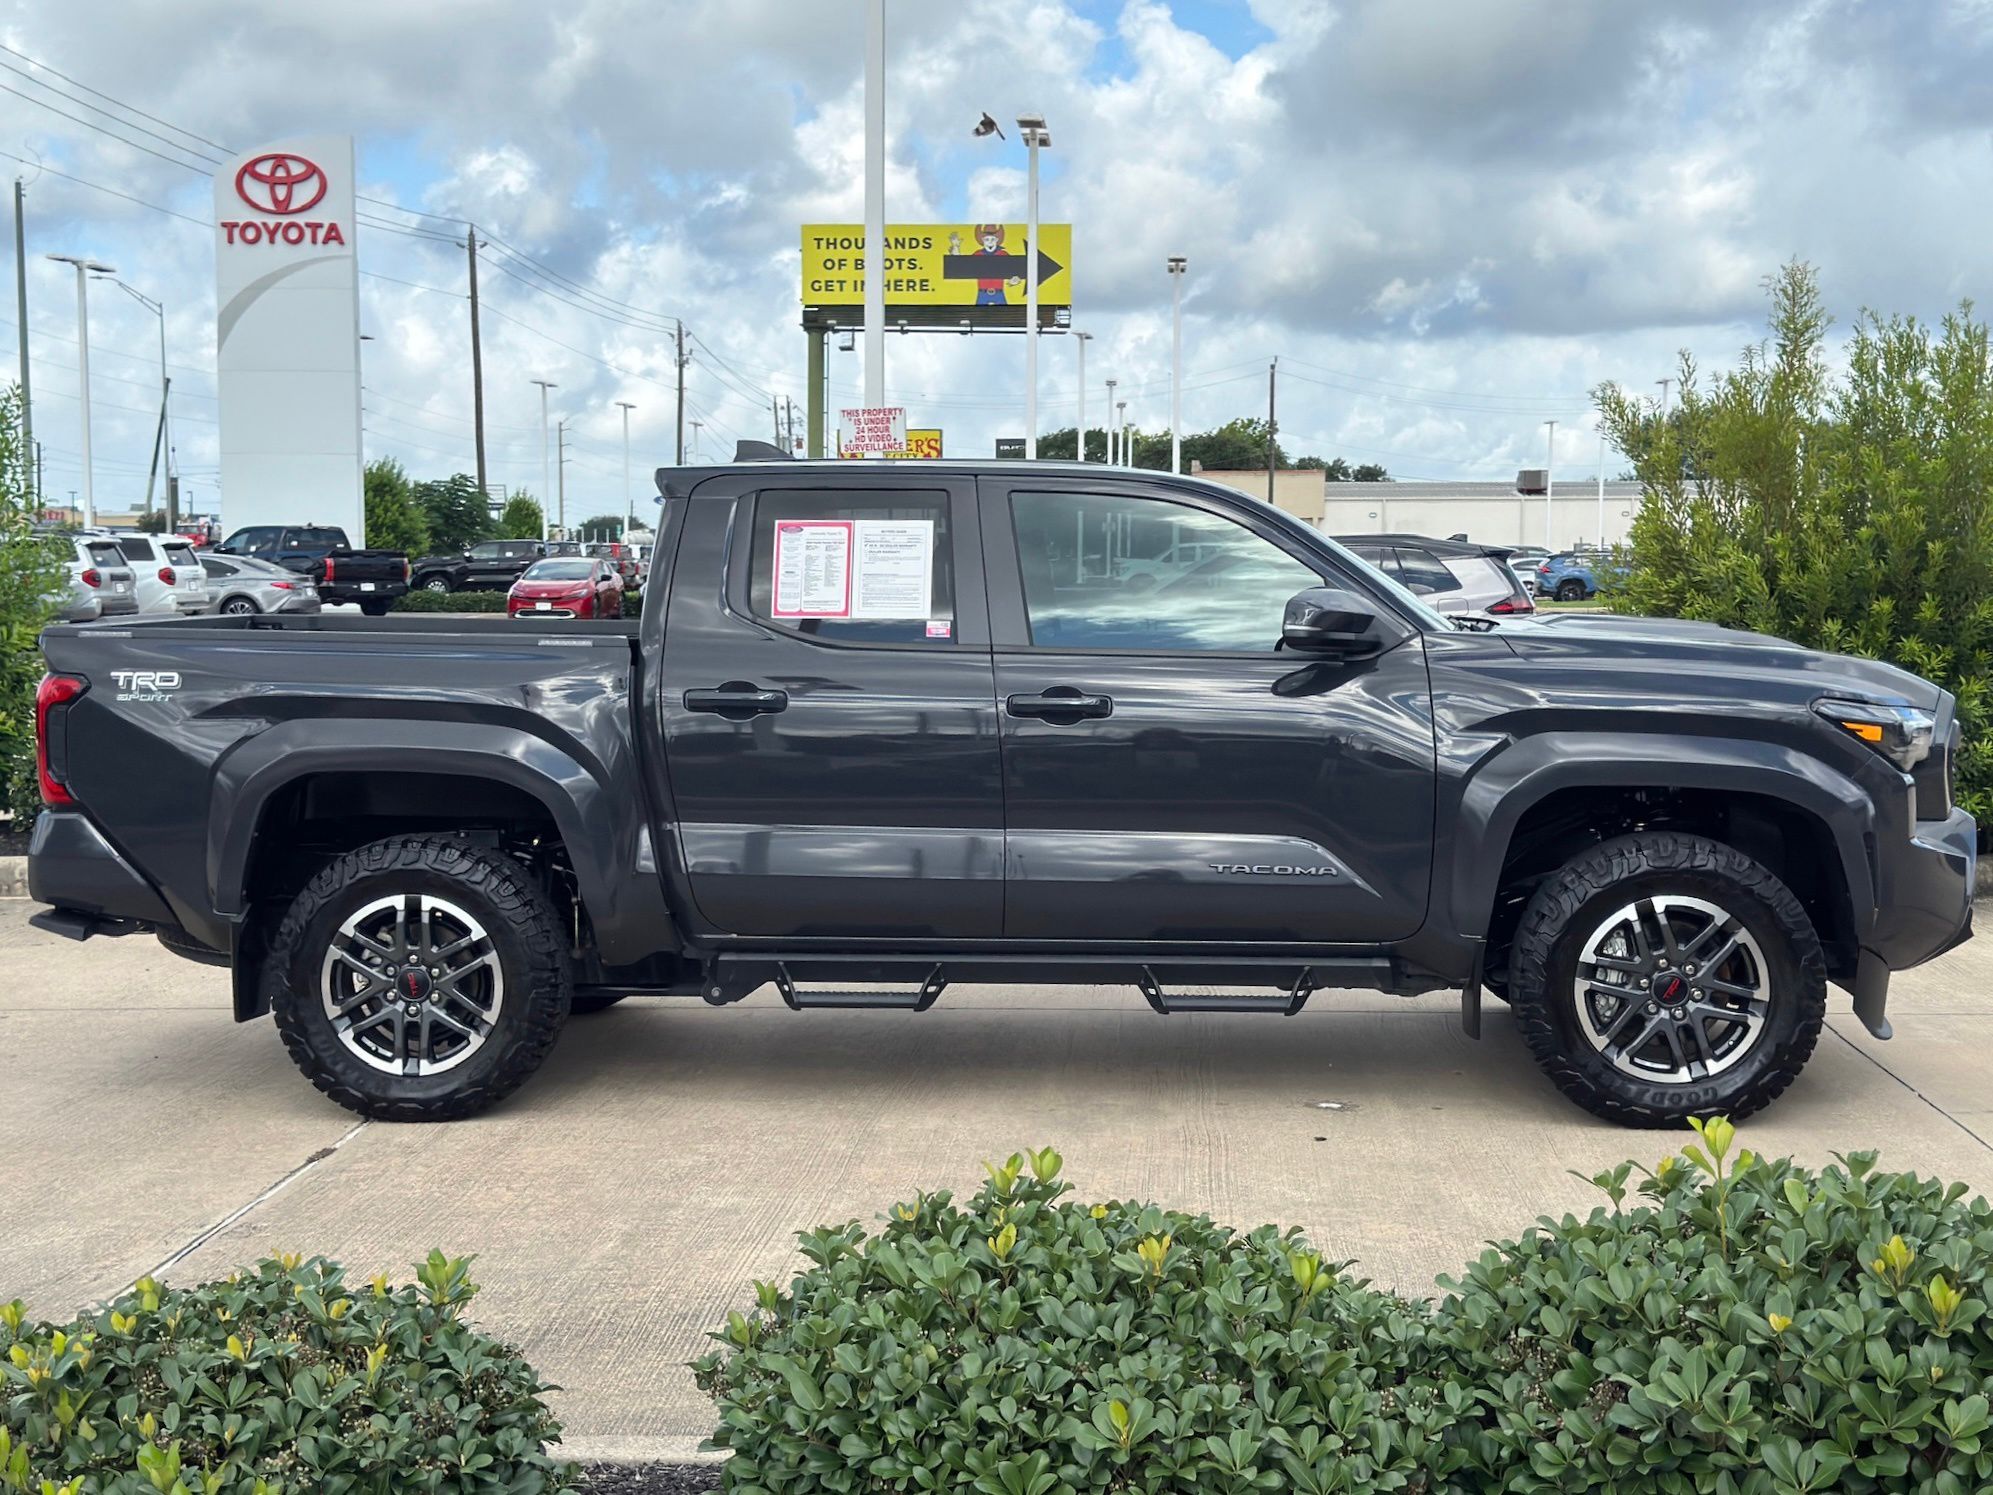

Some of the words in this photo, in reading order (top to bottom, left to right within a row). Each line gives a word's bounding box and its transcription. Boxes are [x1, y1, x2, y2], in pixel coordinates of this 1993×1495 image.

[220, 220, 345, 245] TOYOTA
[813, 237, 933, 250] THOUANDS
[823, 258, 848, 270] OF
[854, 258, 923, 270] BOTS.
[810, 280, 847, 292] GET
[841, 409, 860, 418] THIS
[862, 407, 904, 417] PROPERTY
[854, 418, 861, 426] IS
[864, 417, 891, 426] UNDER
[856, 427, 865, 435] 24
[867, 425, 890, 434] HOUR
[855, 435, 866, 443] HD
[867, 434, 892, 443] VIDEO
[844, 442, 904, 452] SURVEILLANCE
[110, 671, 182, 691] TRD
[116, 693, 173, 702] SPORT
[1209, 863, 1338, 876] TACOMA
